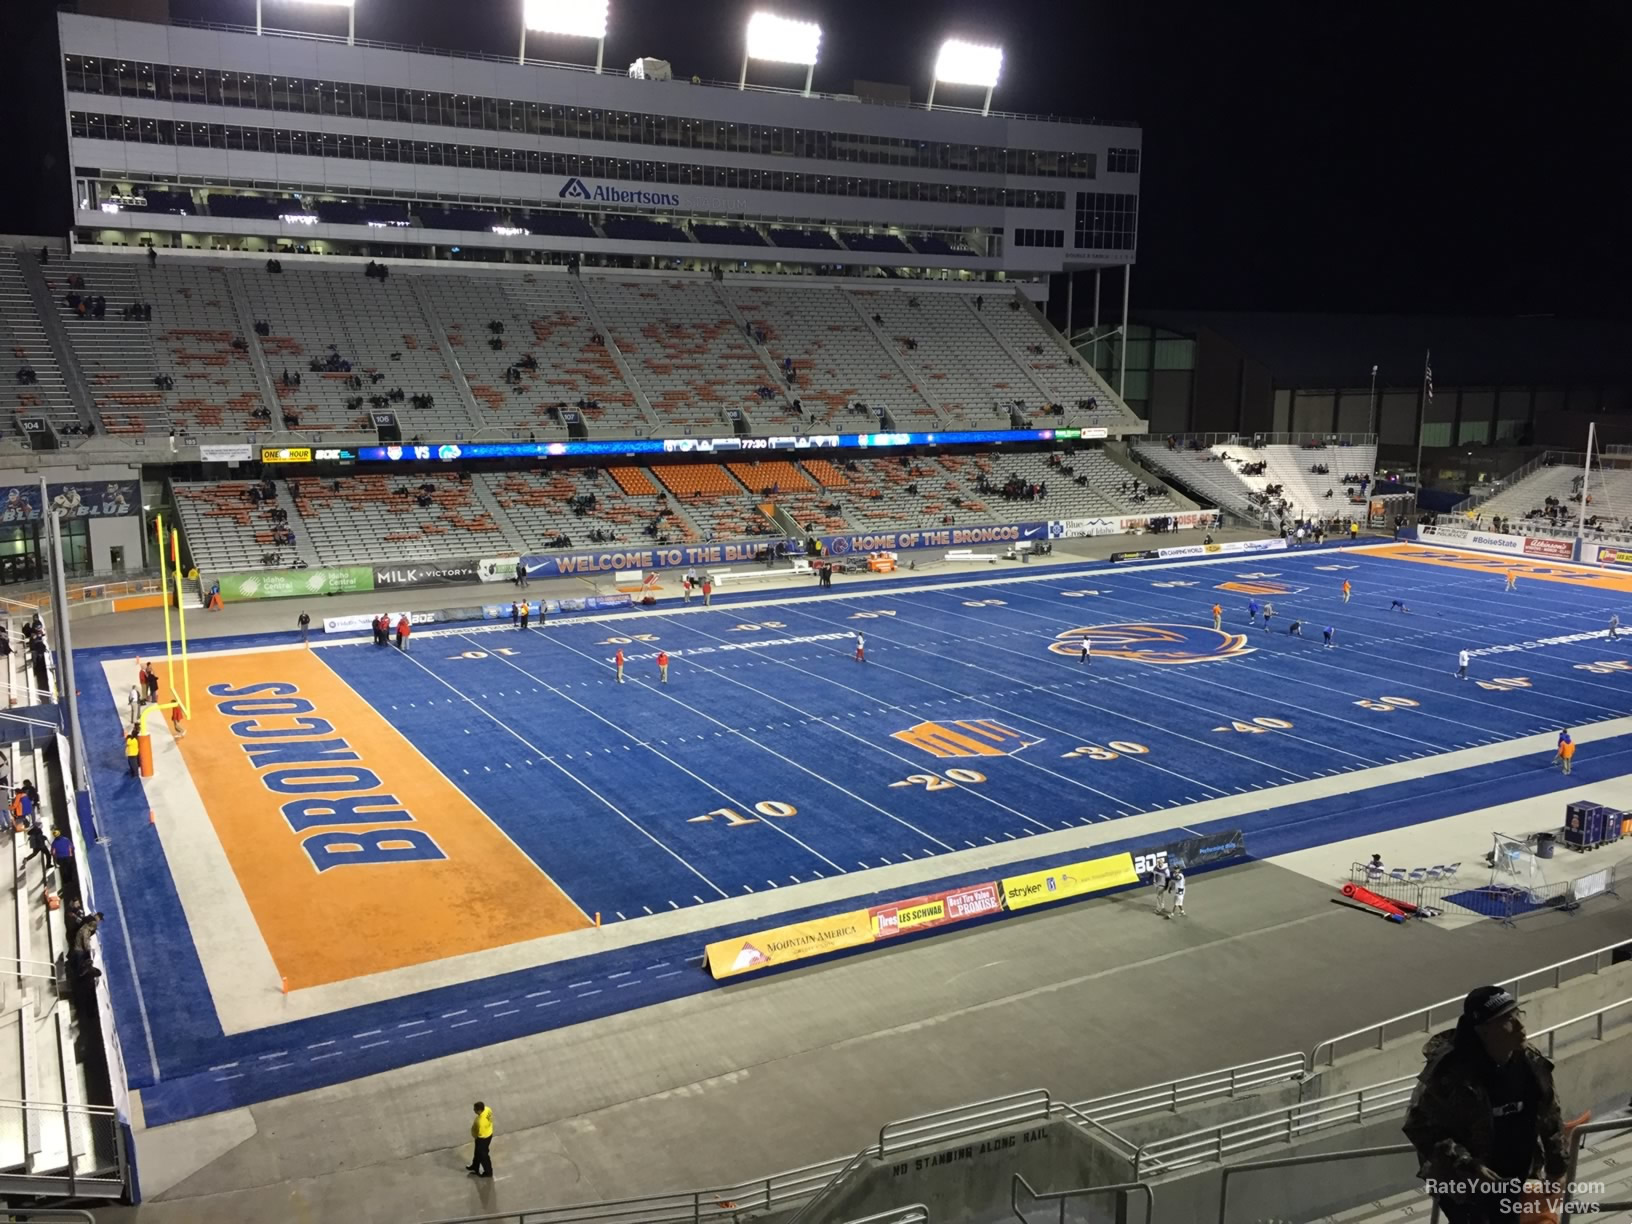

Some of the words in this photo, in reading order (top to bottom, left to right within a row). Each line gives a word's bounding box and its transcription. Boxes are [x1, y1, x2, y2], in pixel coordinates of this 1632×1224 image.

[593, 185, 680, 206] Albertsons
[375, 415, 390, 424] 106
[564, 413, 576, 421] 107
[24, 422, 39, 430] 104
[264, 450, 279, 458] ONE
[289, 450, 309, 458] HOUR
[414, 446, 431, 459] VS
[2, 506, 67, 522] BLED
[77, 504, 131, 515] BLUE
[1065, 520, 1084, 529] Blue
[1095, 527, 1115, 536] Idaho
[852, 534, 896, 551] HOME
[899, 532, 920, 548] OF
[922, 530, 950, 547] THE
[952, 526, 1020, 544] BRONCOS
[1472, 536, 1517, 548] #BoiseState
[555, 551, 653, 574] WELCOME
[657, 548, 683, 566] TO
[686, 546, 721, 563] THE
[726, 543, 768, 561] BLUE
[263, 576, 285, 584] Idaho
[328, 572, 349, 580] Idaho
[329, 578, 357, 586] Central
[377, 569, 418, 584] MILK
[425, 568, 469, 578] VICTORY
[263, 582, 293, 591] Central
[1352, 696, 1421, 713] 50
[1230, 717, 1294, 734] 40
[1075, 740, 1150, 761] 30
[207, 682, 450, 875] BRONCOS
[907, 768, 988, 792] 20
[708, 800, 799, 827] 10
[1135, 851, 1169, 874] BOE
[1008, 883, 1043, 899] stryker
[899, 912, 911, 923] LES
[912, 905, 943, 920] SCHWAB
[957, 896, 997, 916] PROMISE
[767, 935, 815, 952] MOUNTAIN
[817, 926, 857, 942] AMERICA
[892, 1163, 908, 1177] NO
[915, 1146, 973, 1171] STANDING
[979, 1135, 1016, 1154] ALONG
[1023, 1128, 1049, 1144] RAIL
